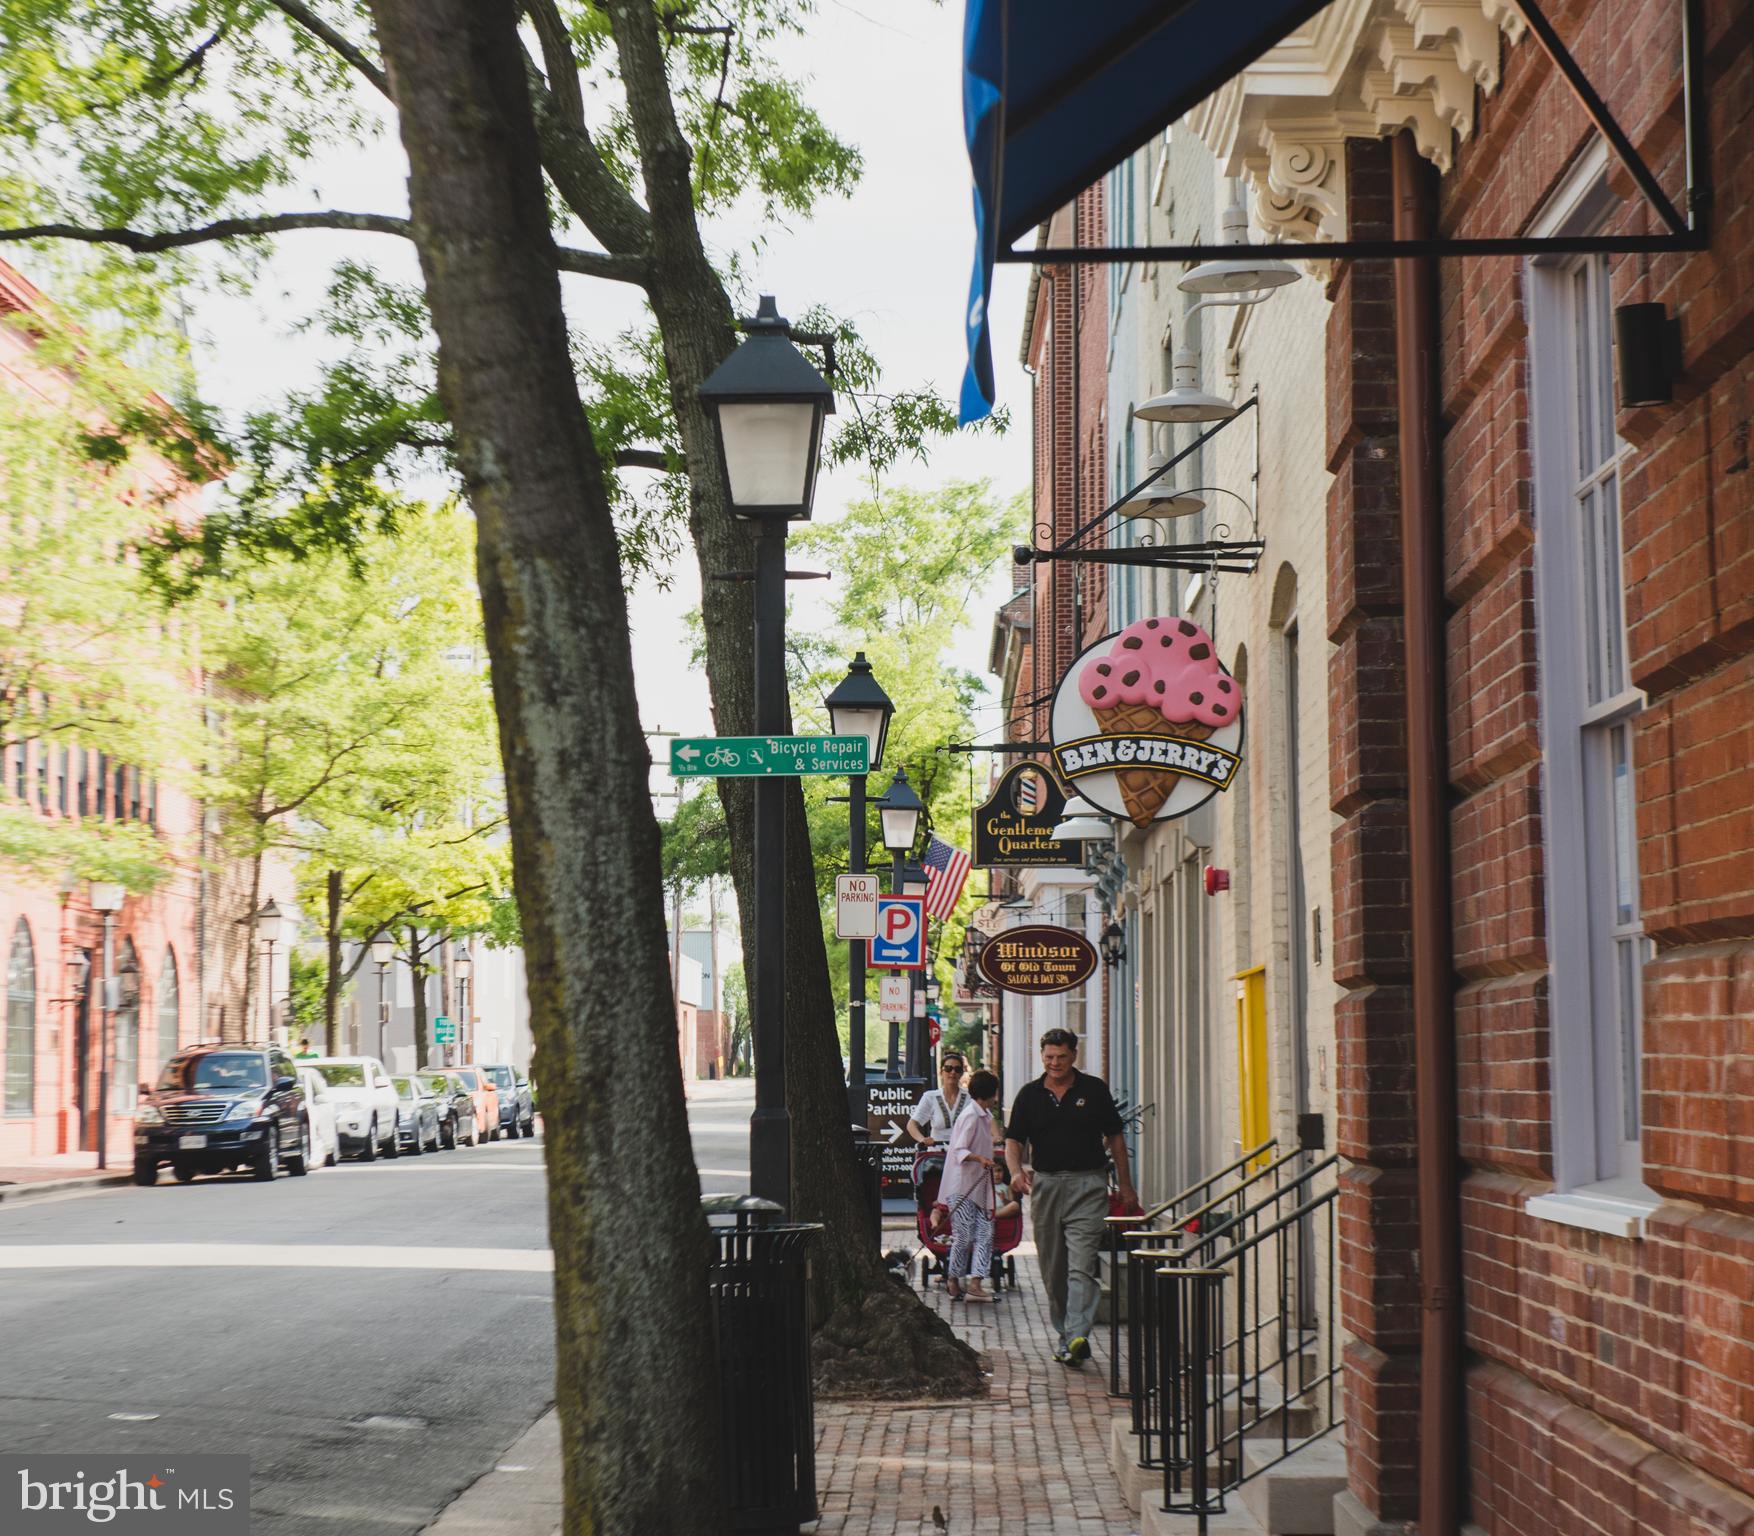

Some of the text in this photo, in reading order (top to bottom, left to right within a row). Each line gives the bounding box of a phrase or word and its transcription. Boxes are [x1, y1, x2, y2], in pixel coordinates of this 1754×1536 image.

[771, 740, 862, 757] Bicycle Repair
[794, 757, 863, 770] & Services
[1000, 810, 1011, 819] the
[998, 836, 1061, 855] Quarters
[849, 880, 866, 892] NO
[841, 893, 874, 903] PARKING
[886, 908, 911, 940] P
[996, 943, 1080, 958] Windsor
[1000, 961, 1076, 972] Of Old Town
[1007, 974, 1069, 984] SALON & DAY SPA
[889, 986, 900, 995] NO
[881, 1003, 908, 1011] PARKING
[870, 1087, 912, 1100] Public
